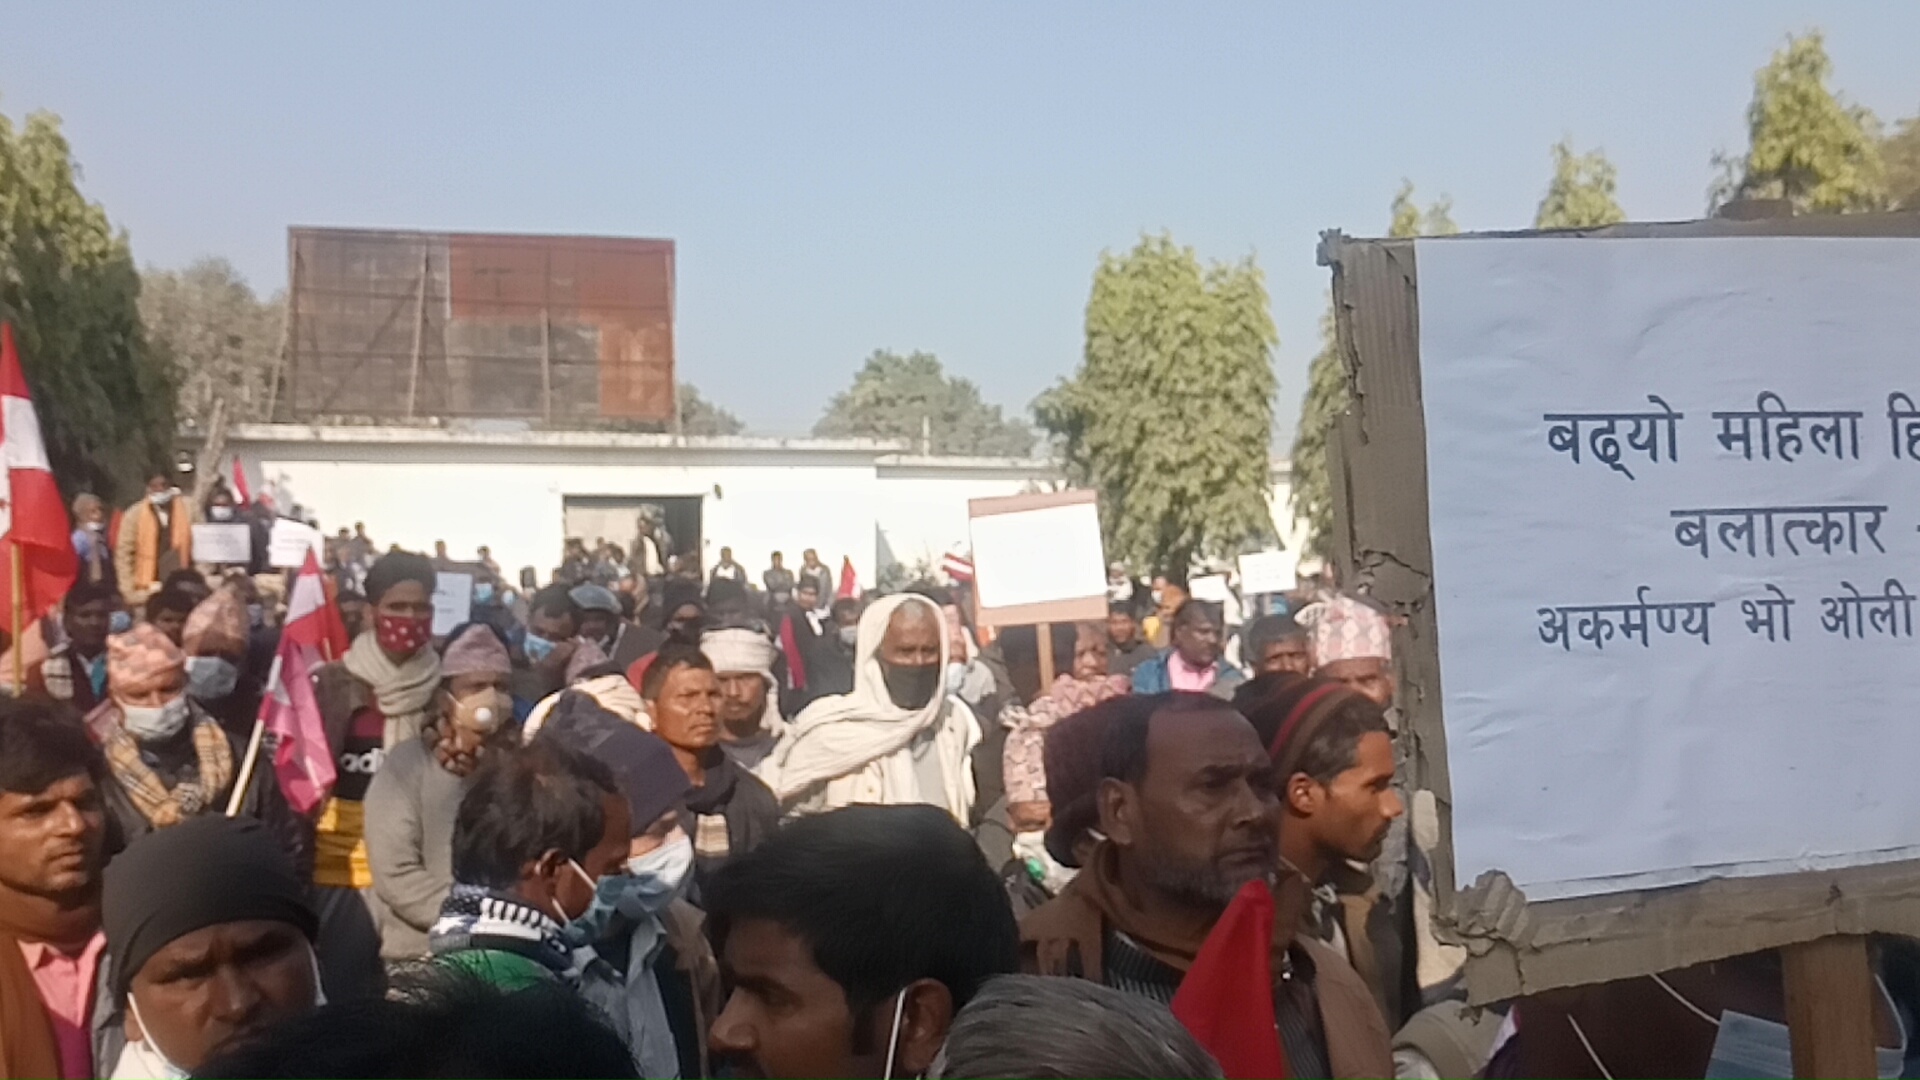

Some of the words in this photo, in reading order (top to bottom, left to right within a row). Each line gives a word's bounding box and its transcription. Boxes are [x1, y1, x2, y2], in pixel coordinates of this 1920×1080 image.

[1711, 390, 1864, 463] महिला
[1670, 505, 1889, 559] बलात्कार
[1537, 585, 1716, 652] अकर्मण्य
[1741, 583, 1796, 643] भो
[1820, 578, 1918, 639] ओली
